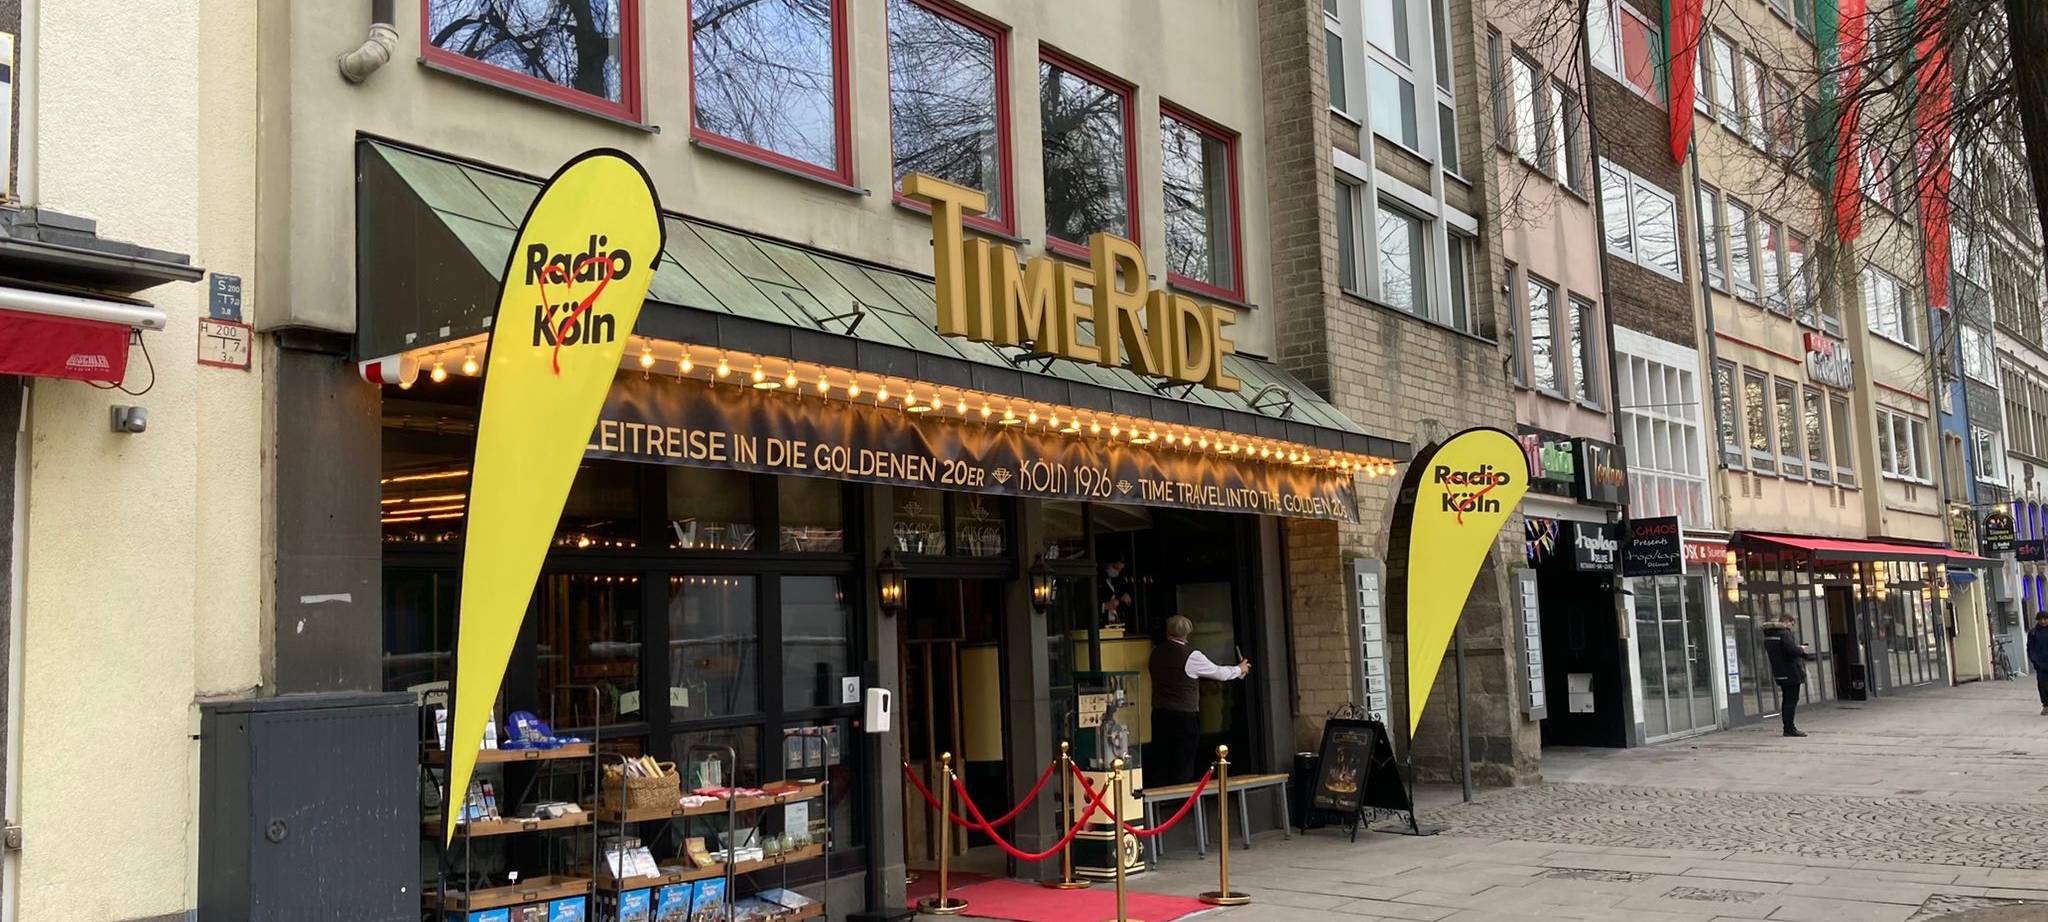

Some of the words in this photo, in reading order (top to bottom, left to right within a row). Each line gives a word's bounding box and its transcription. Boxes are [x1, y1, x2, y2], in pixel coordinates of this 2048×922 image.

[525, 234, 632, 285] Radio
[218, 280, 226, 291] S
[227, 285, 241, 293] 200
[201, 323, 208, 332] H
[216, 325, 237, 337] 200
[532, 301, 615, 346] Köln
[585, 419, 727, 461] EITREISE
[733, 433, 757, 465] IN
[767, 437, 808, 469] DIE
[814, 443, 937, 483] GOLDENEN
[1073, 465, 1112, 498] 1926
[1138, 478, 1174, 502] TIME
[1176, 482, 1225, 507] TRAVEL
[1226, 488, 1258, 508] INTO
[1260, 490, 1282, 512] THE
[1284, 494, 1332, 515] GOLDEN
[1434, 464, 1510, 486] Radio
[1442, 492, 1500, 512] Köln
[1633, 538, 1669, 547] Presents
[1684, 543, 1698, 561] OSK
[2018, 544, 2040, 556] sky
